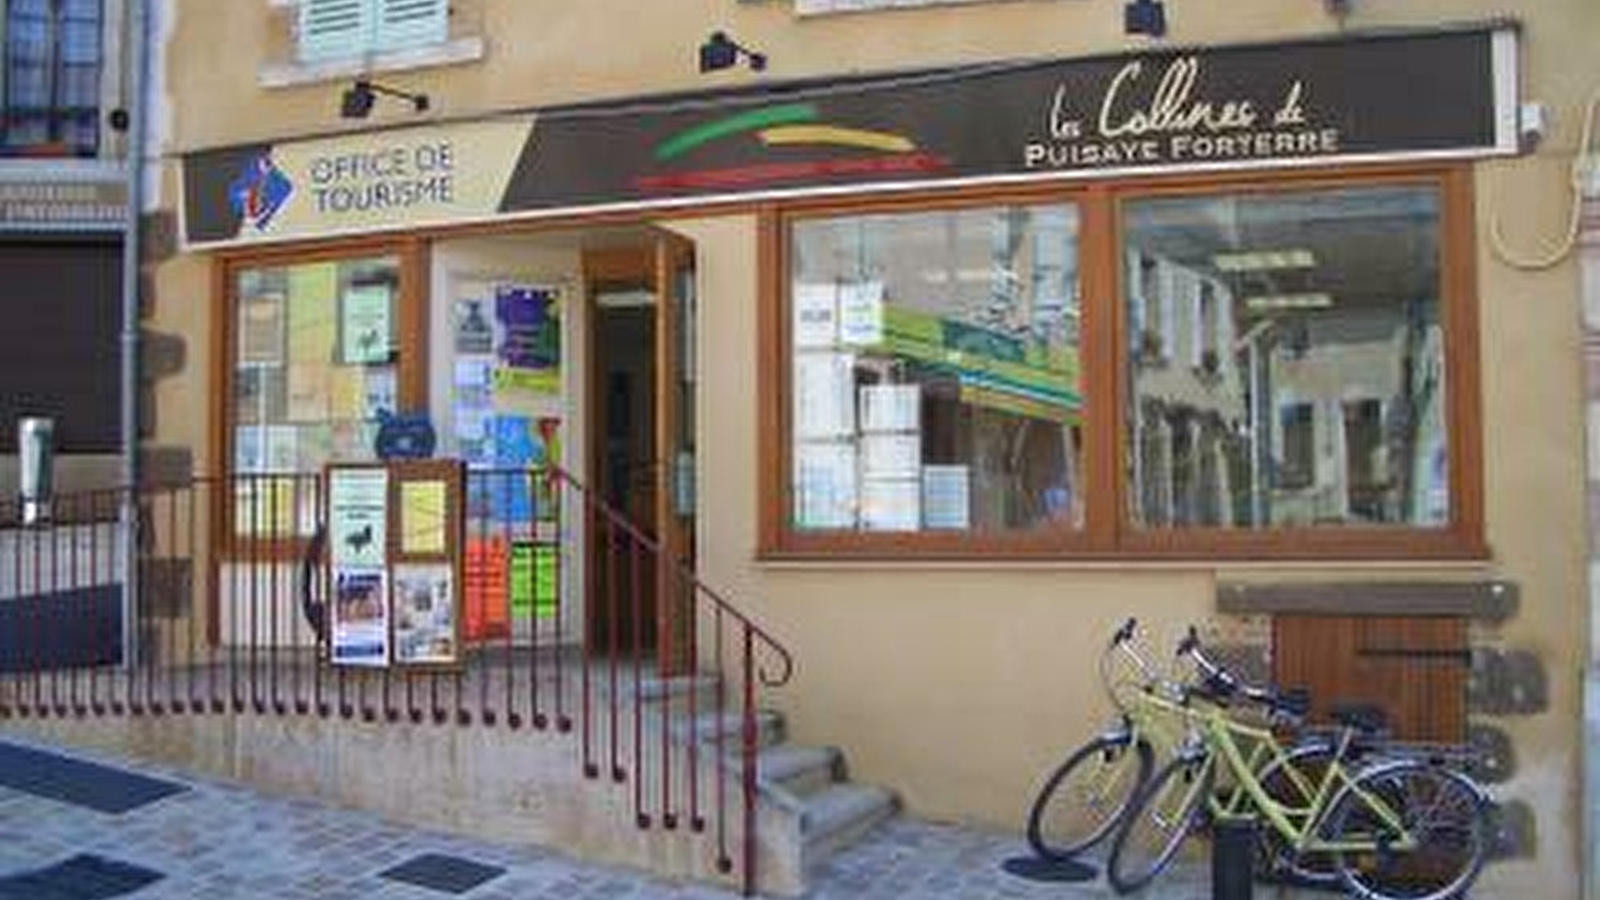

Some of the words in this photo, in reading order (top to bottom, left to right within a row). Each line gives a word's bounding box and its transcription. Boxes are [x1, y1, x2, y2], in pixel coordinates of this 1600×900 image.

[1100, 57, 1257, 136] Collines
[1274, 81, 1304, 123] de
[311, 151, 409, 184] OFFICE
[415, 143, 453, 170] DE
[1025, 141, 1159, 167] PUISAYE
[1171, 129, 1341, 158] FORTERRE
[316, 177, 453, 212] TOURISME
